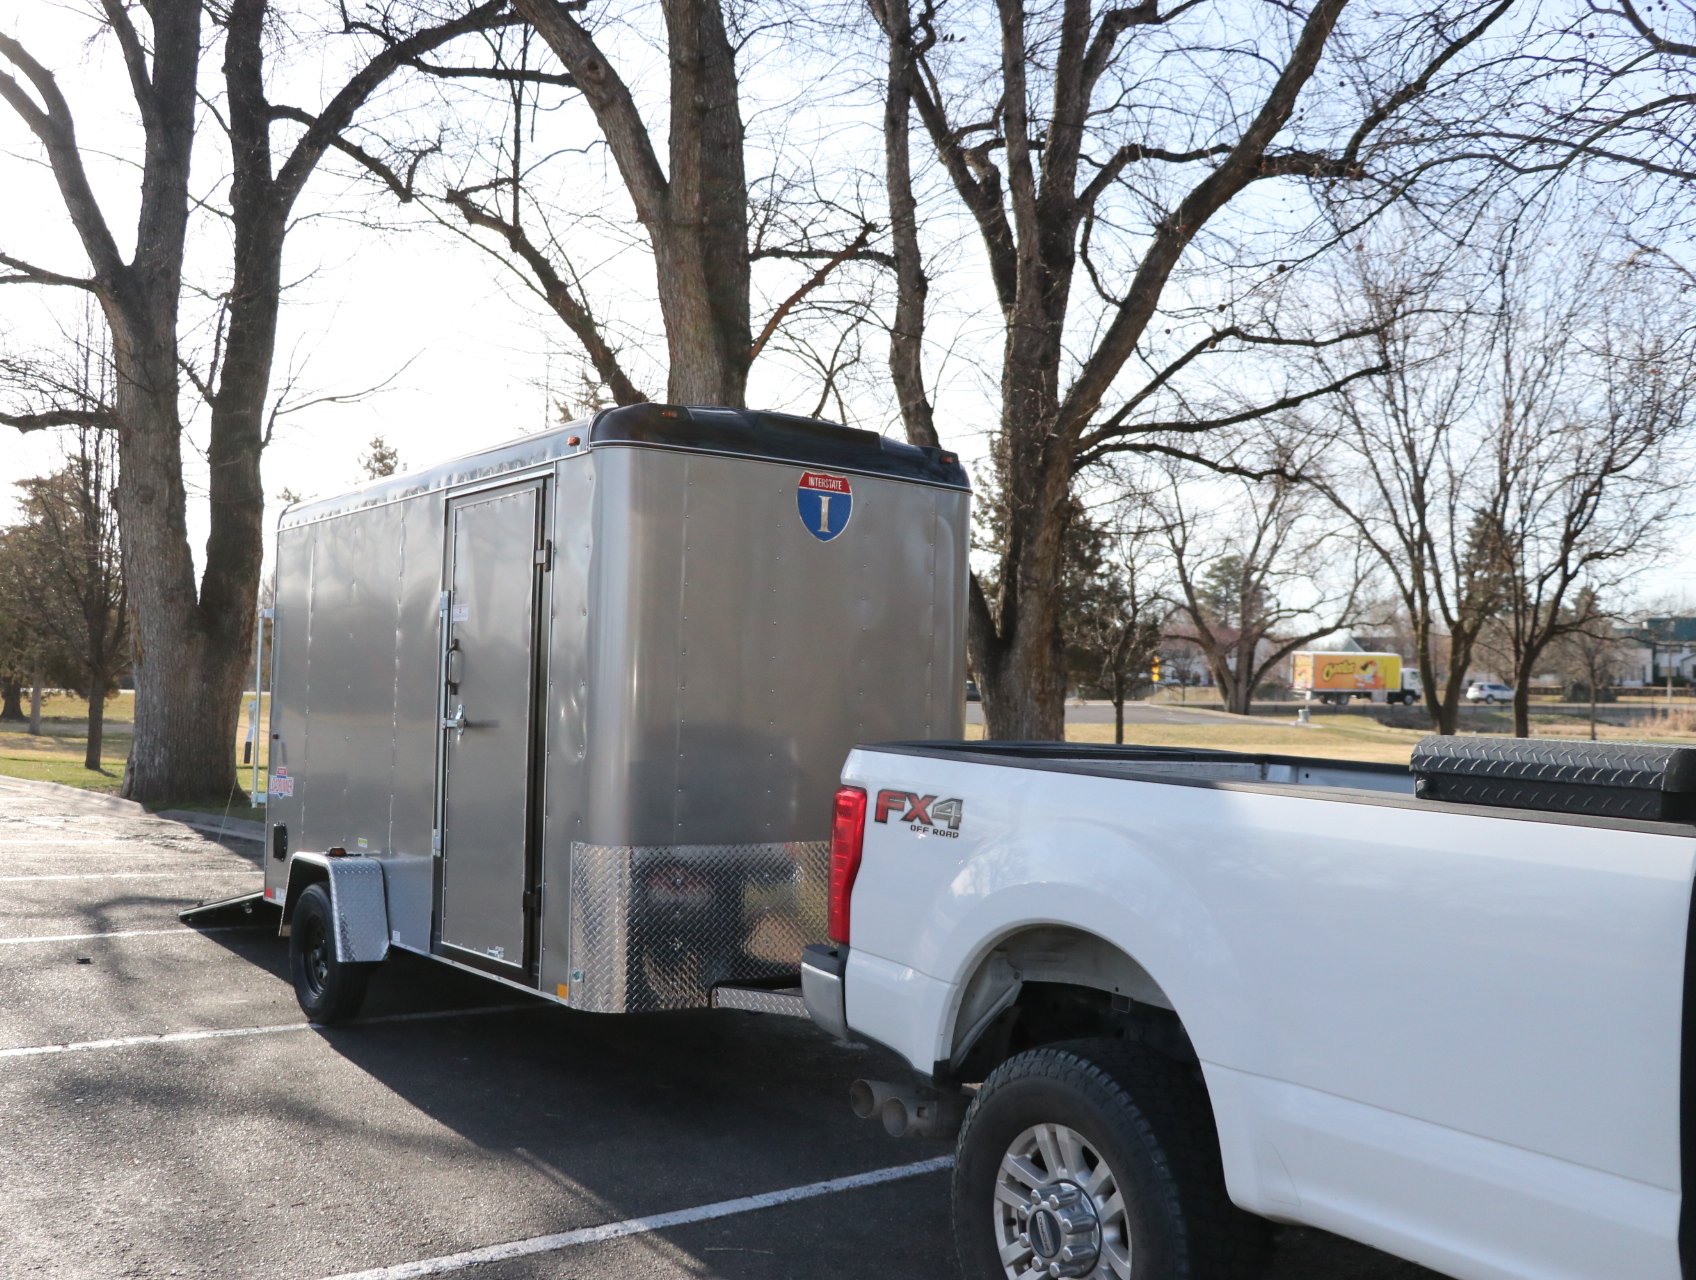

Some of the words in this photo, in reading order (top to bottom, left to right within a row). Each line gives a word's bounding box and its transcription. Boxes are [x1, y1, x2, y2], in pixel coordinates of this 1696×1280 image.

[808, 476, 842, 490] INTERSTATE
[875, 789, 963, 830] FX4
[910, 824, 929, 833] OFF
[932, 828, 959, 838] ROAD
